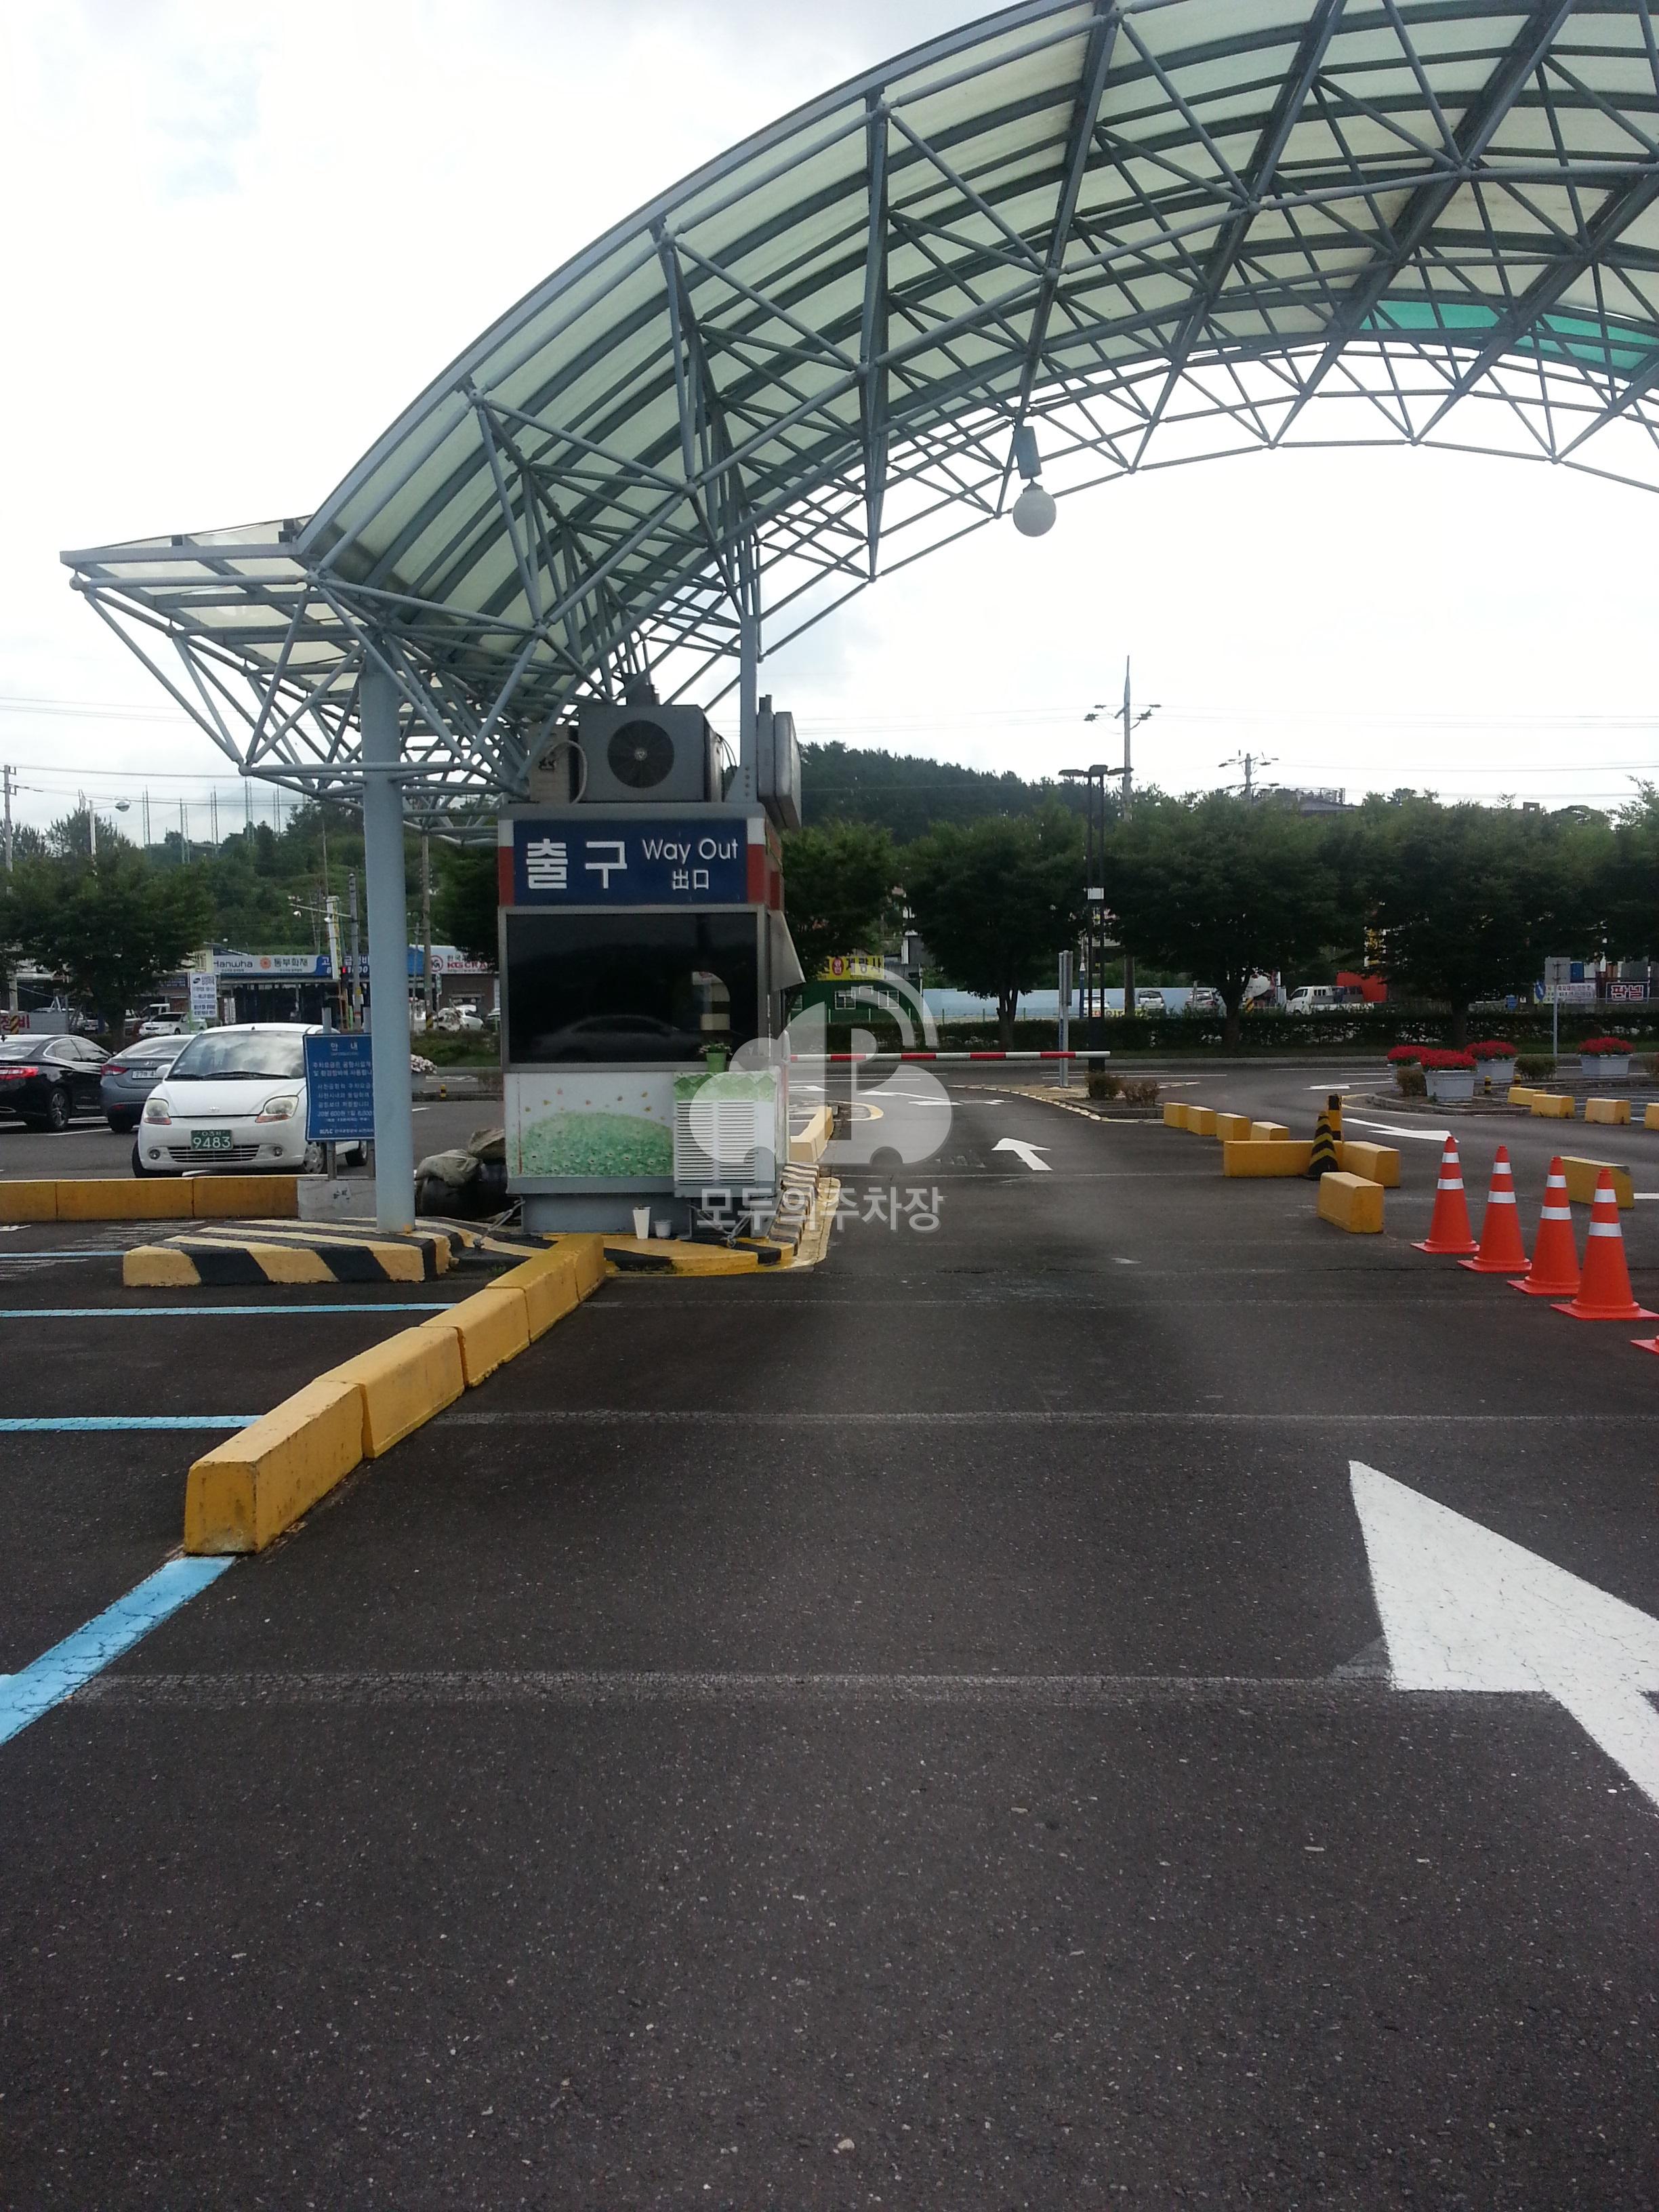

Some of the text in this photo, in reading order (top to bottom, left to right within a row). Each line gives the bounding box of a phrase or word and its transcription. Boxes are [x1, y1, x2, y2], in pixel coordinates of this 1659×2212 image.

[642, 838, 739, 865] Way Out
[672, 869, 710, 890] 出口
[273, 957, 308, 968] 동부화재
[1611, 985, 1644, 1001] 판넬
[192, 1136, 231, 1149] 9483
